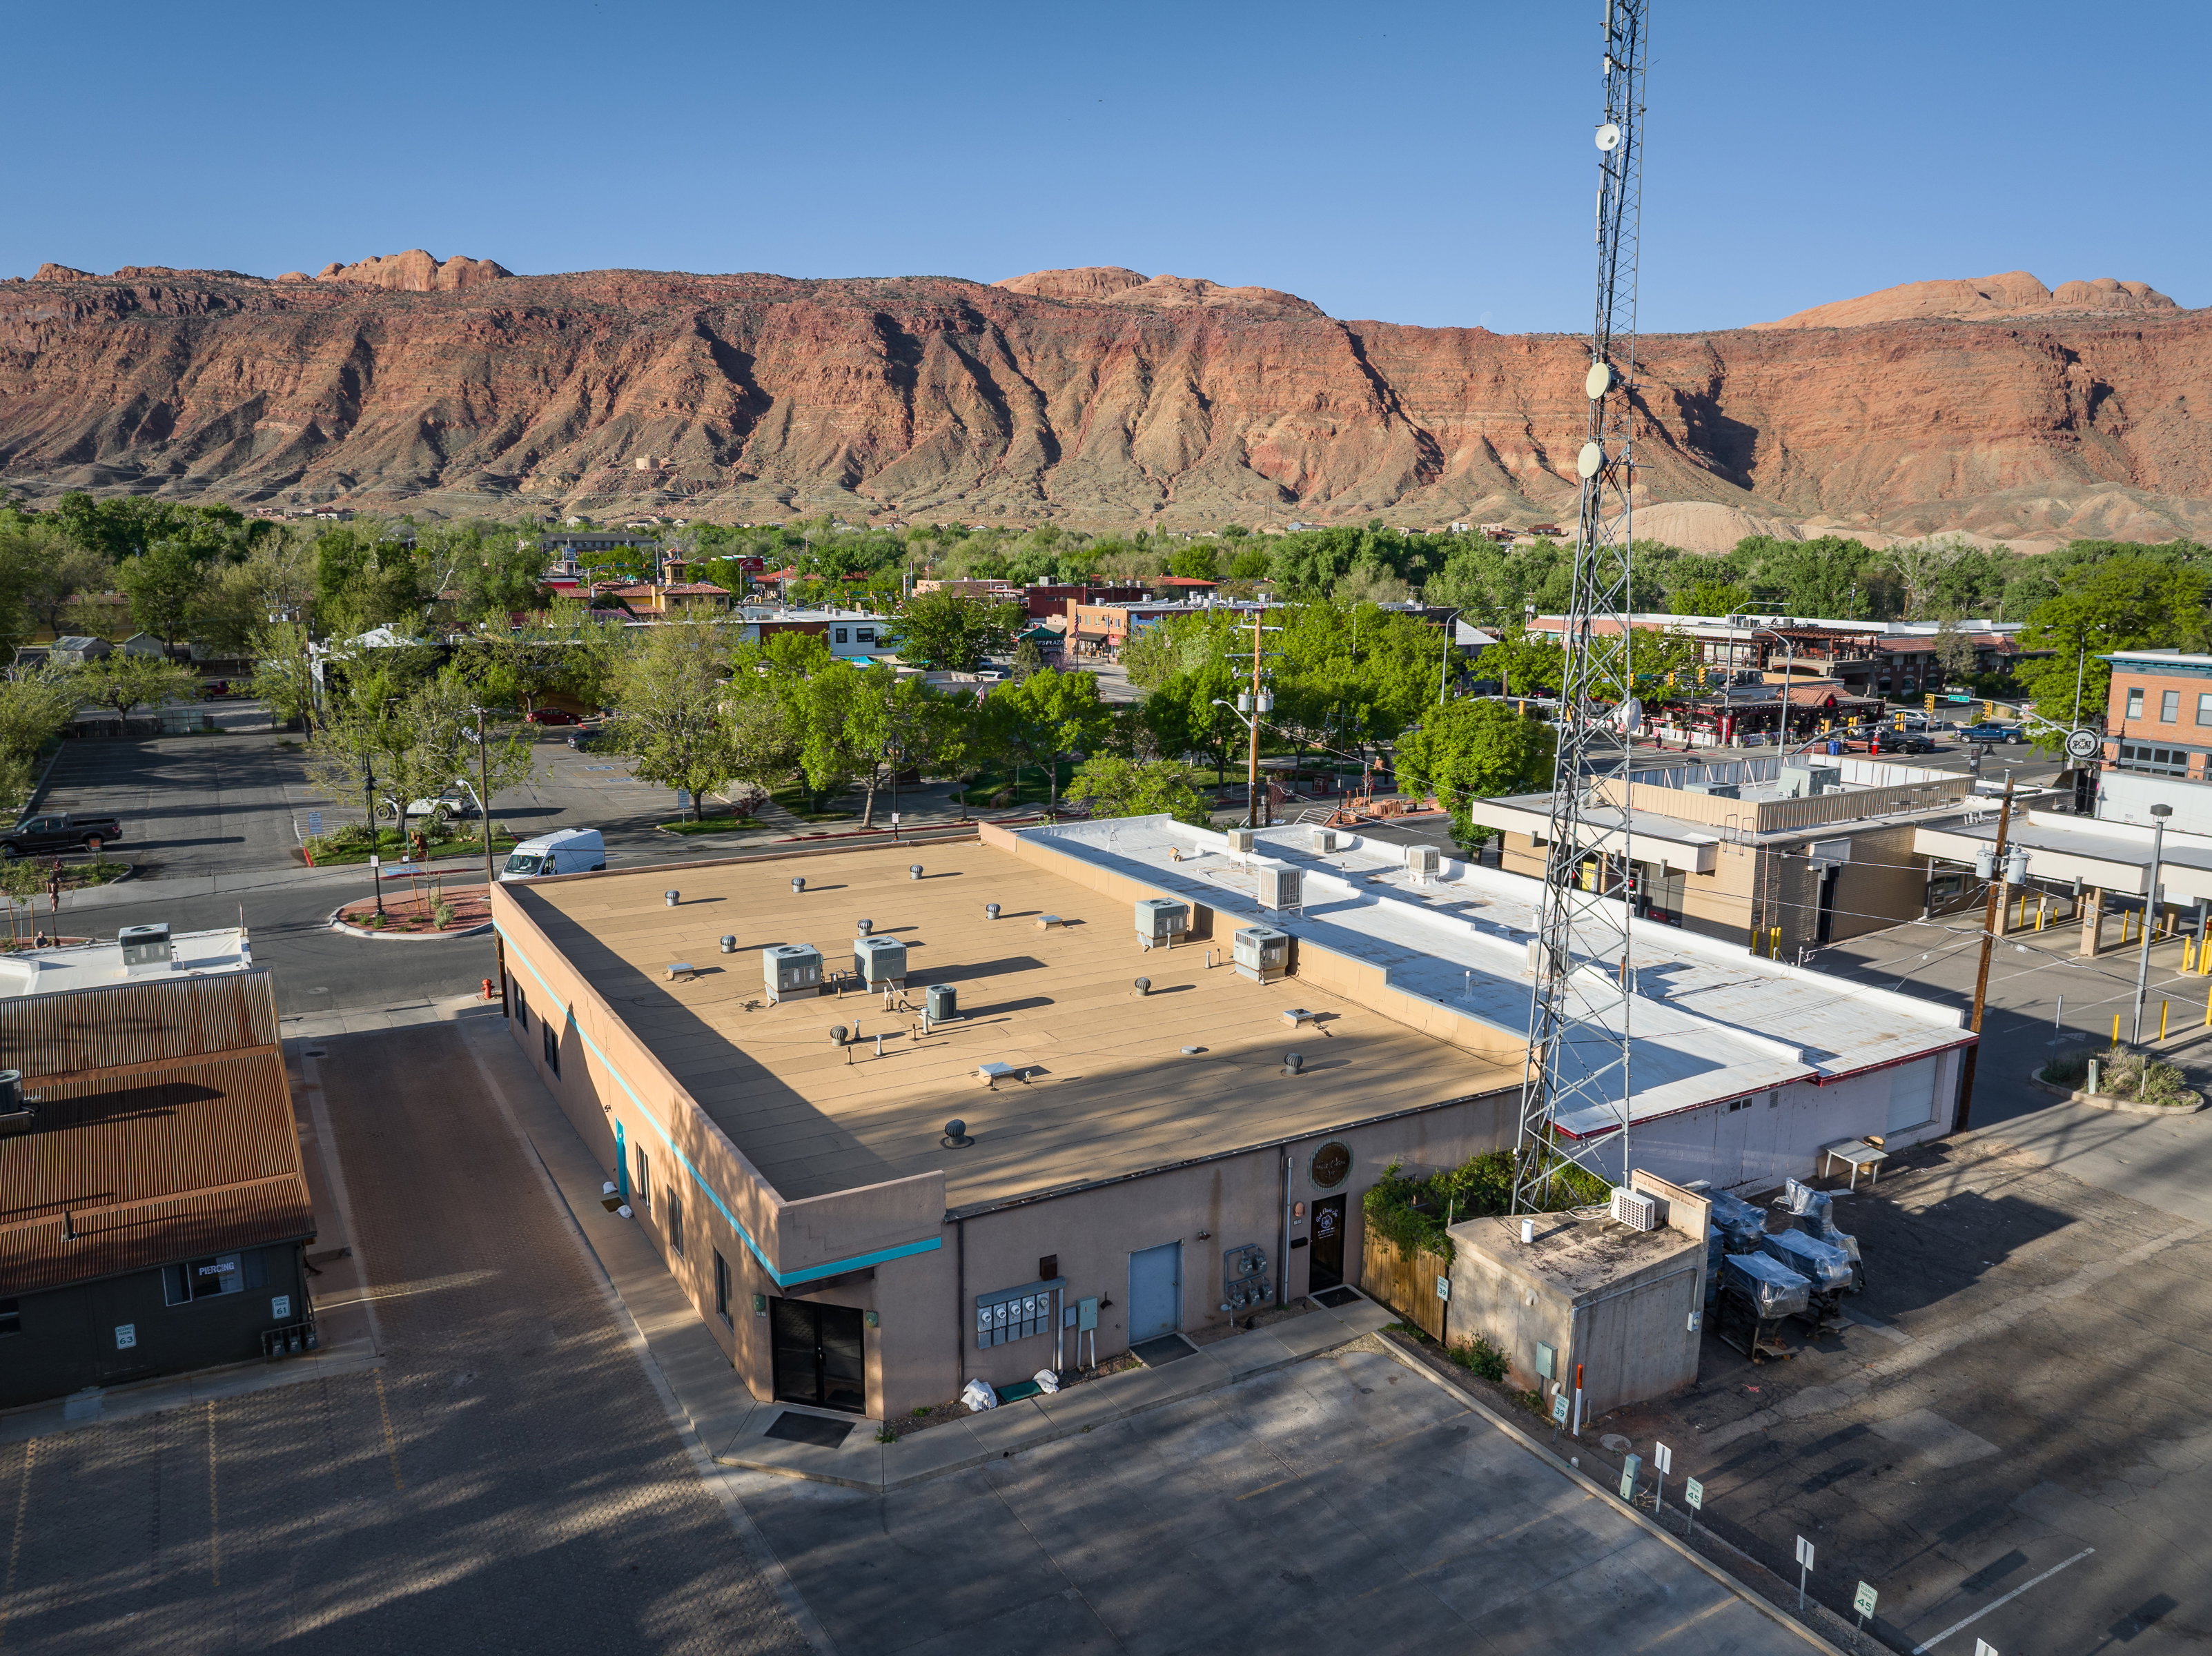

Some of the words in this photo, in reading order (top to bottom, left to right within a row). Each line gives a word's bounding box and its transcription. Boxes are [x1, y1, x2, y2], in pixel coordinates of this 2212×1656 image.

[199, 1262, 235, 1276] PIERCING
[1439, 1288, 1446, 1296] 39
[1555, 1408, 1565, 1417] 39
[1688, 1492, 1699, 1503] 45
[1860, 1590, 1873, 1601] PARKING
[1861, 1584, 1875, 1597] RESERVED
[1857, 1599, 1872, 1611] 45
